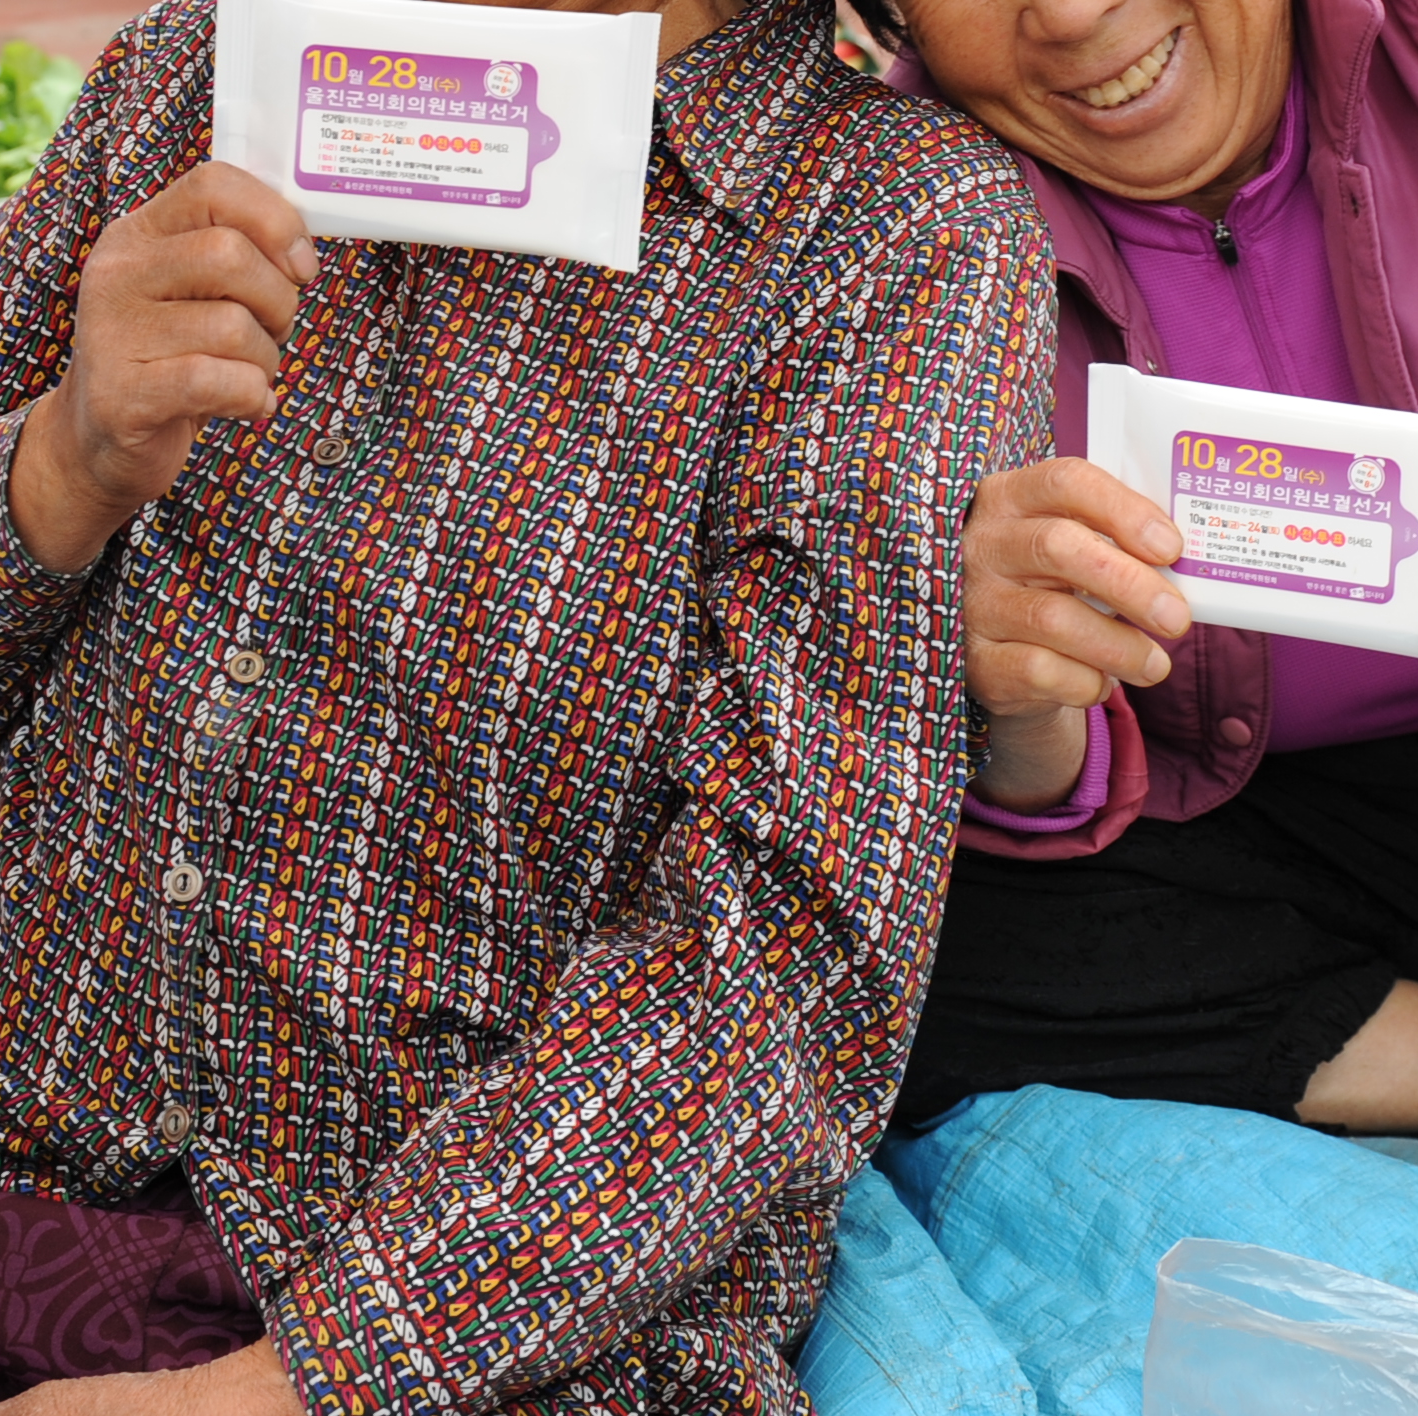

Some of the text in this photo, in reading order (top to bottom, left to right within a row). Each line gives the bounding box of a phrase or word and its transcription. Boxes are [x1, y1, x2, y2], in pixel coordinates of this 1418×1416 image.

[306, 50, 461, 93] 10월 28일(수)
[305, 87, 528, 123] 울진군의회의원보궐선거
[321, 128, 338, 140] 10월
[420, 135, 481, 153] 사전투표
[484, 143, 509, 154] 하세요
[344, 182, 413, 194] 울진군선거관리위원회
[1177, 435, 1325, 486] 10월 28일(수)
[1176, 471, 1391, 518] 울진군의회의원보궐선거
[1189, 513, 1205, 526] 10월
[1284, 525, 1346, 546] 사전투표
[1348, 536, 1372, 548] 하세요
[1211, 567, 1277, 585] 울진군선거관리위원회
